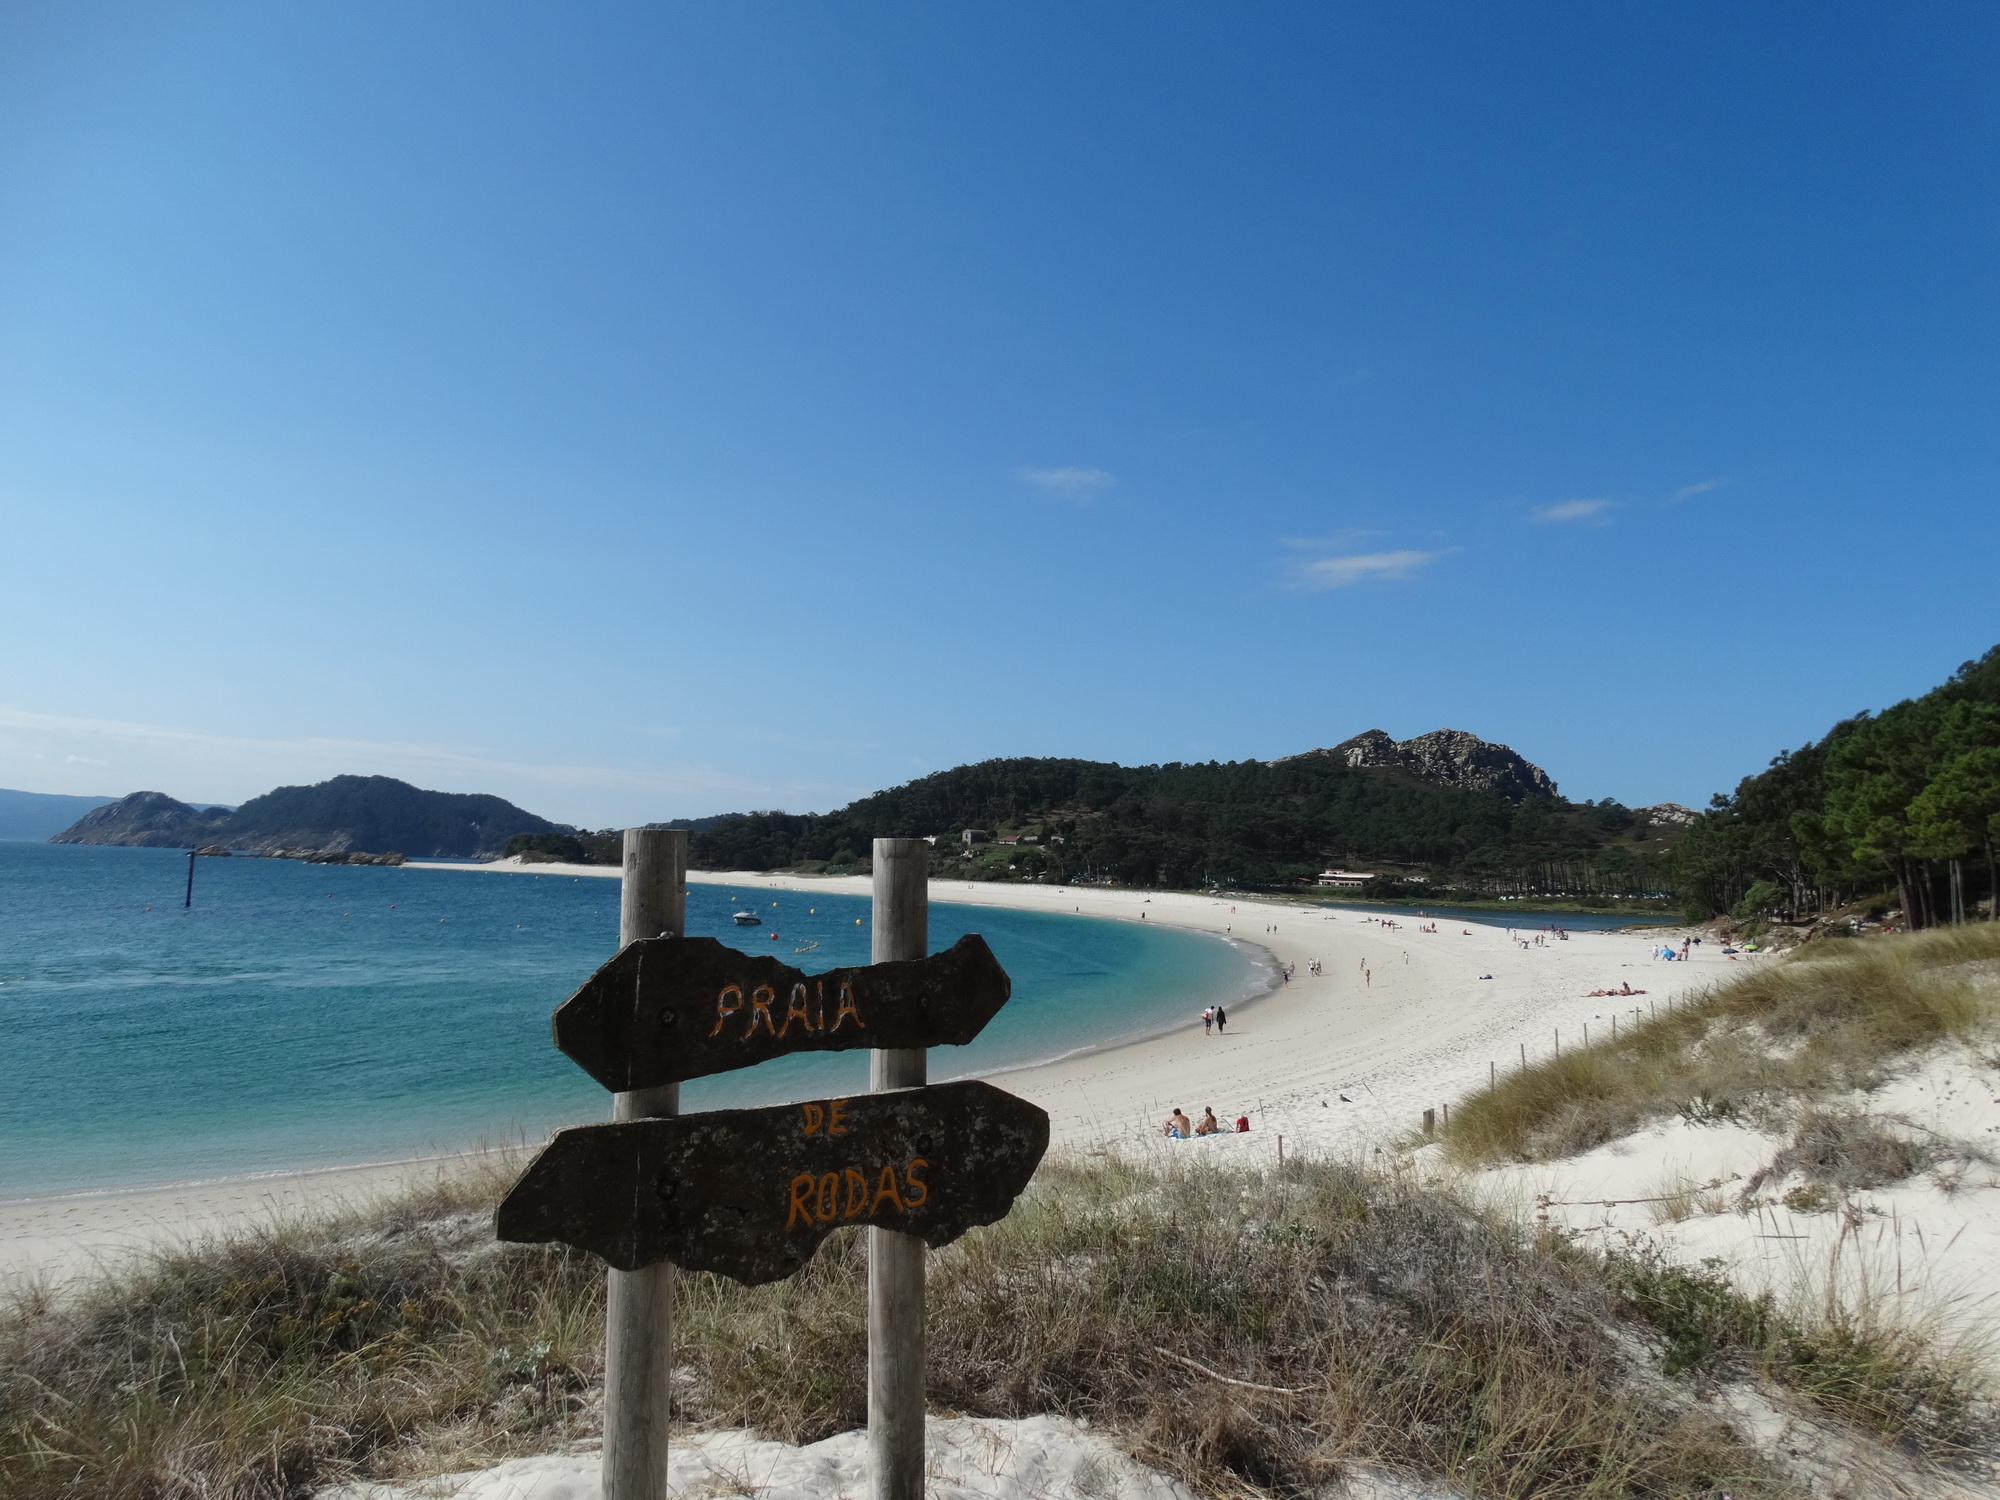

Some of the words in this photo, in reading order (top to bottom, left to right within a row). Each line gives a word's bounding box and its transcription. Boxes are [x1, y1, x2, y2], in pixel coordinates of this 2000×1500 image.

[707, 980, 866, 1040] PRAIA
[802, 1099, 849, 1136] DE
[785, 1158, 929, 1230] RODAS
